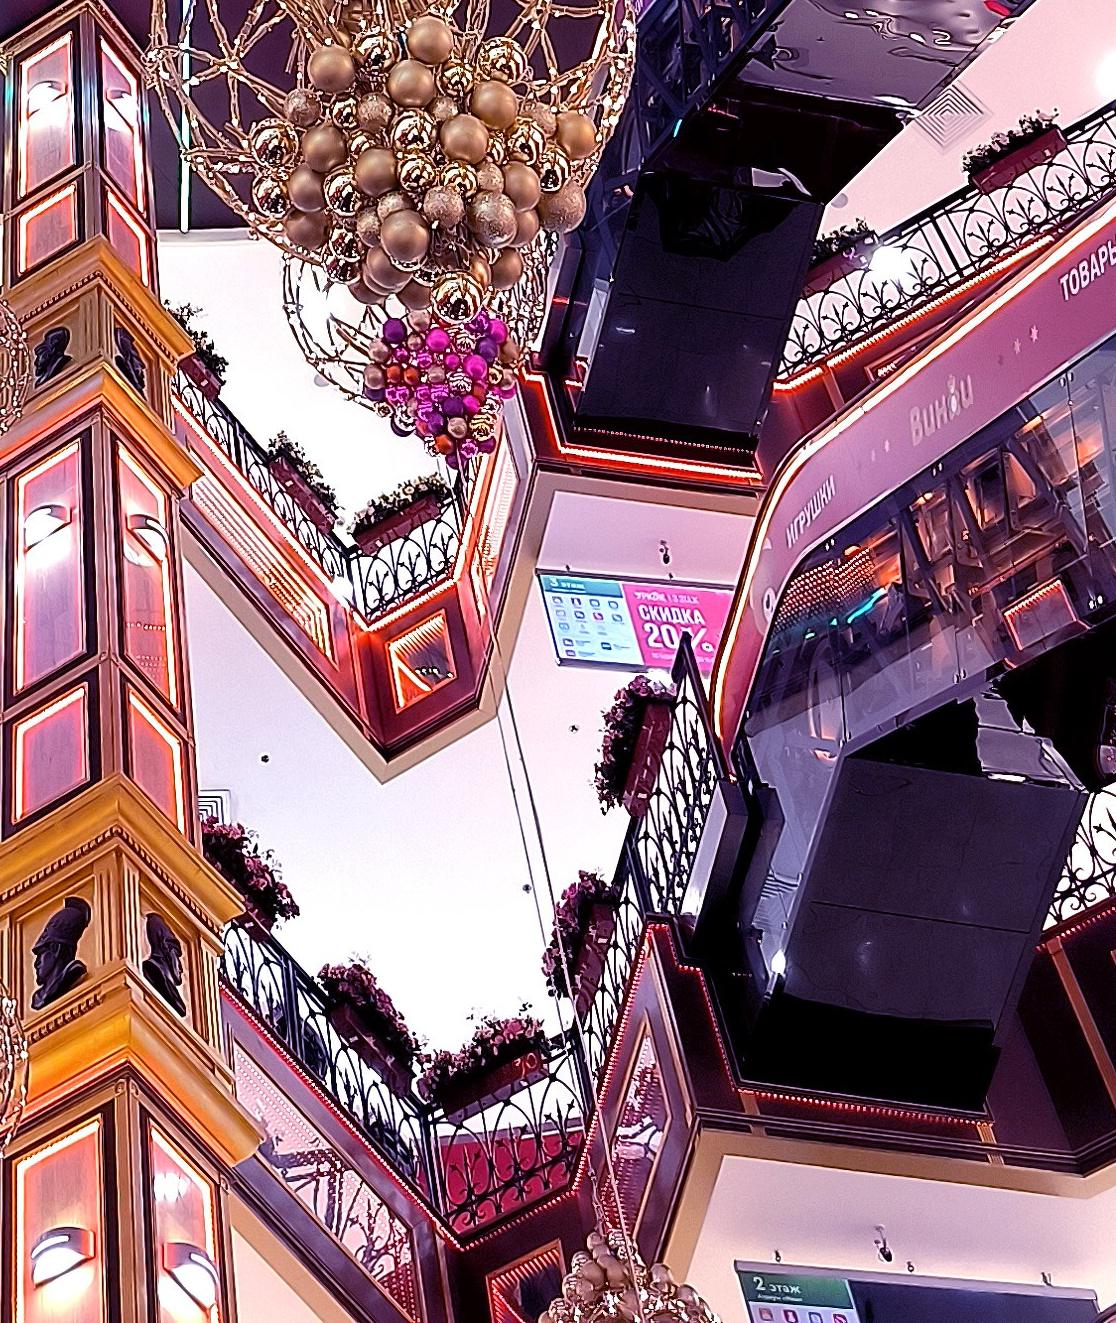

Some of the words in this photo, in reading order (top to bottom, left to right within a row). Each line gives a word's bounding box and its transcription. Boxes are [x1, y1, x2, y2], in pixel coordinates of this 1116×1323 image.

[786, 475, 836, 549] ИГРУШКИ
[638, 604, 706, 626] СКИДКА
[753, 1276, 767, 1291] 2
[769, 1283, 801, 1294] этаж
